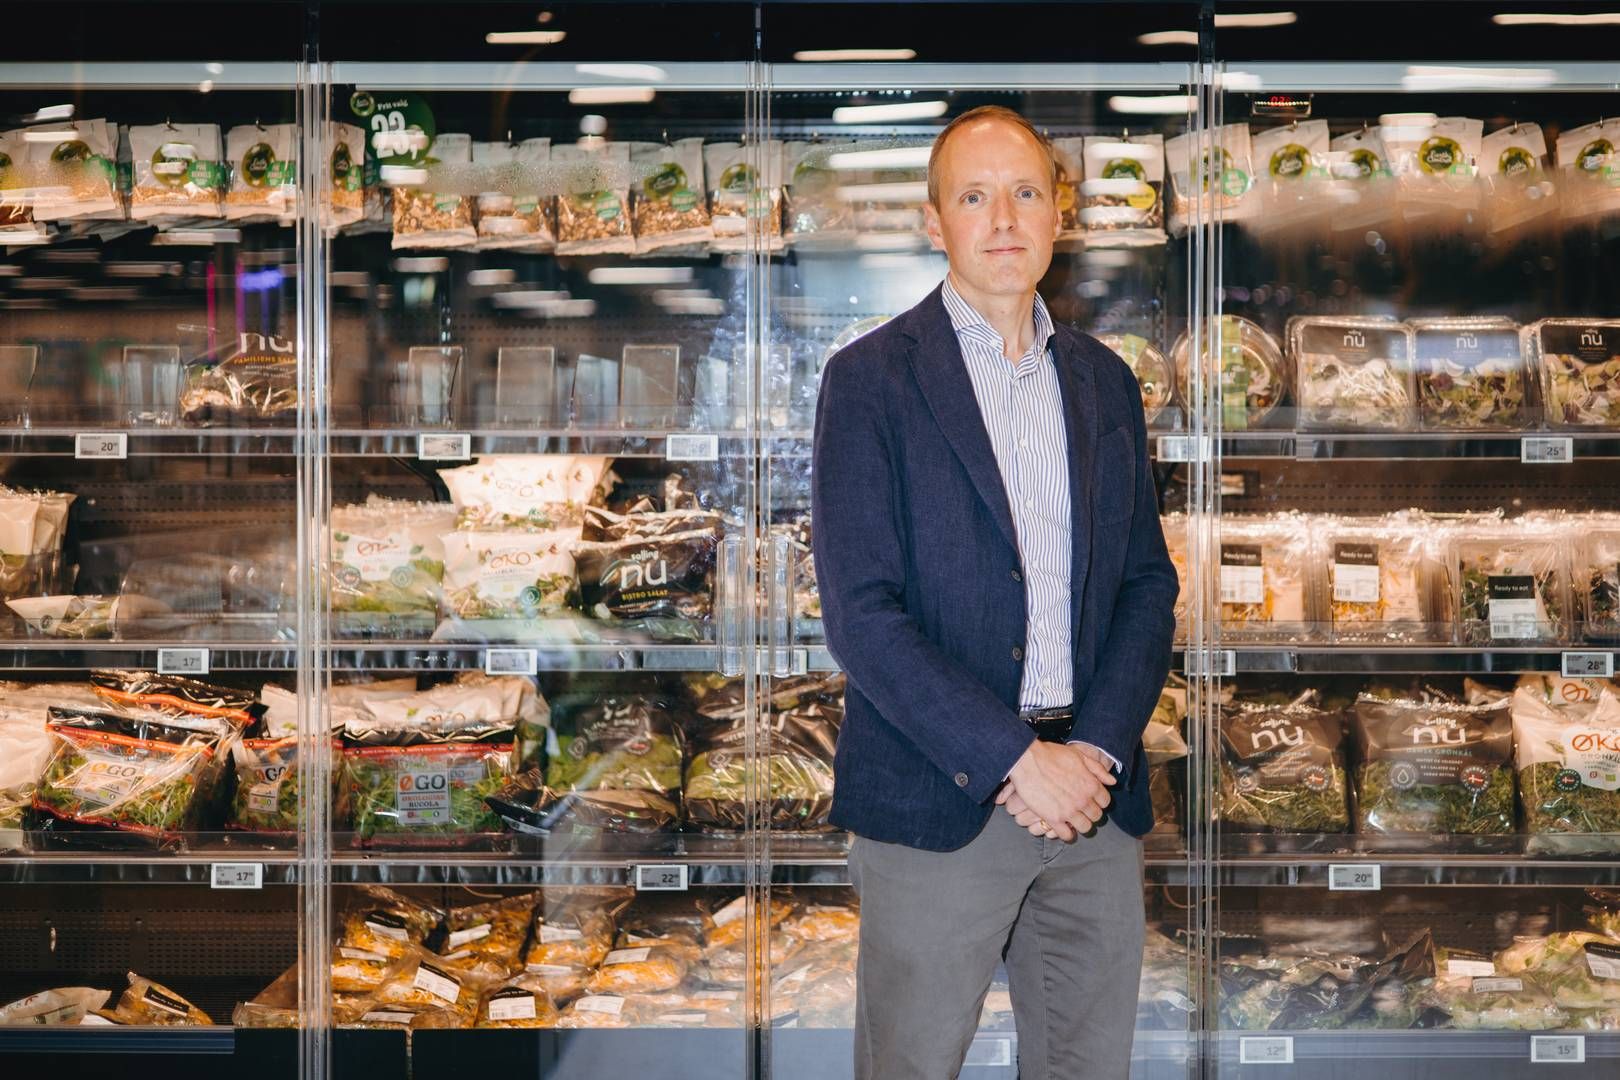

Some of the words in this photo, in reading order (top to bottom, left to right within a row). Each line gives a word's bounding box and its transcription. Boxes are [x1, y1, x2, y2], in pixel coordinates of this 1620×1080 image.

[240, 332, 293, 353] nu
[1343, 335, 1366, 348] nu
[1455, 336, 1479, 349] nu
[1580, 332, 1603, 346] nu
[631, 549, 659, 561] salling
[620, 559, 667, 590] nu
[621, 591, 646, 601] BISTRO
[1251, 726, 1304, 749] nu
[1413, 726, 1466, 744] nu
[408, 800, 440, 808] RUCOLA
